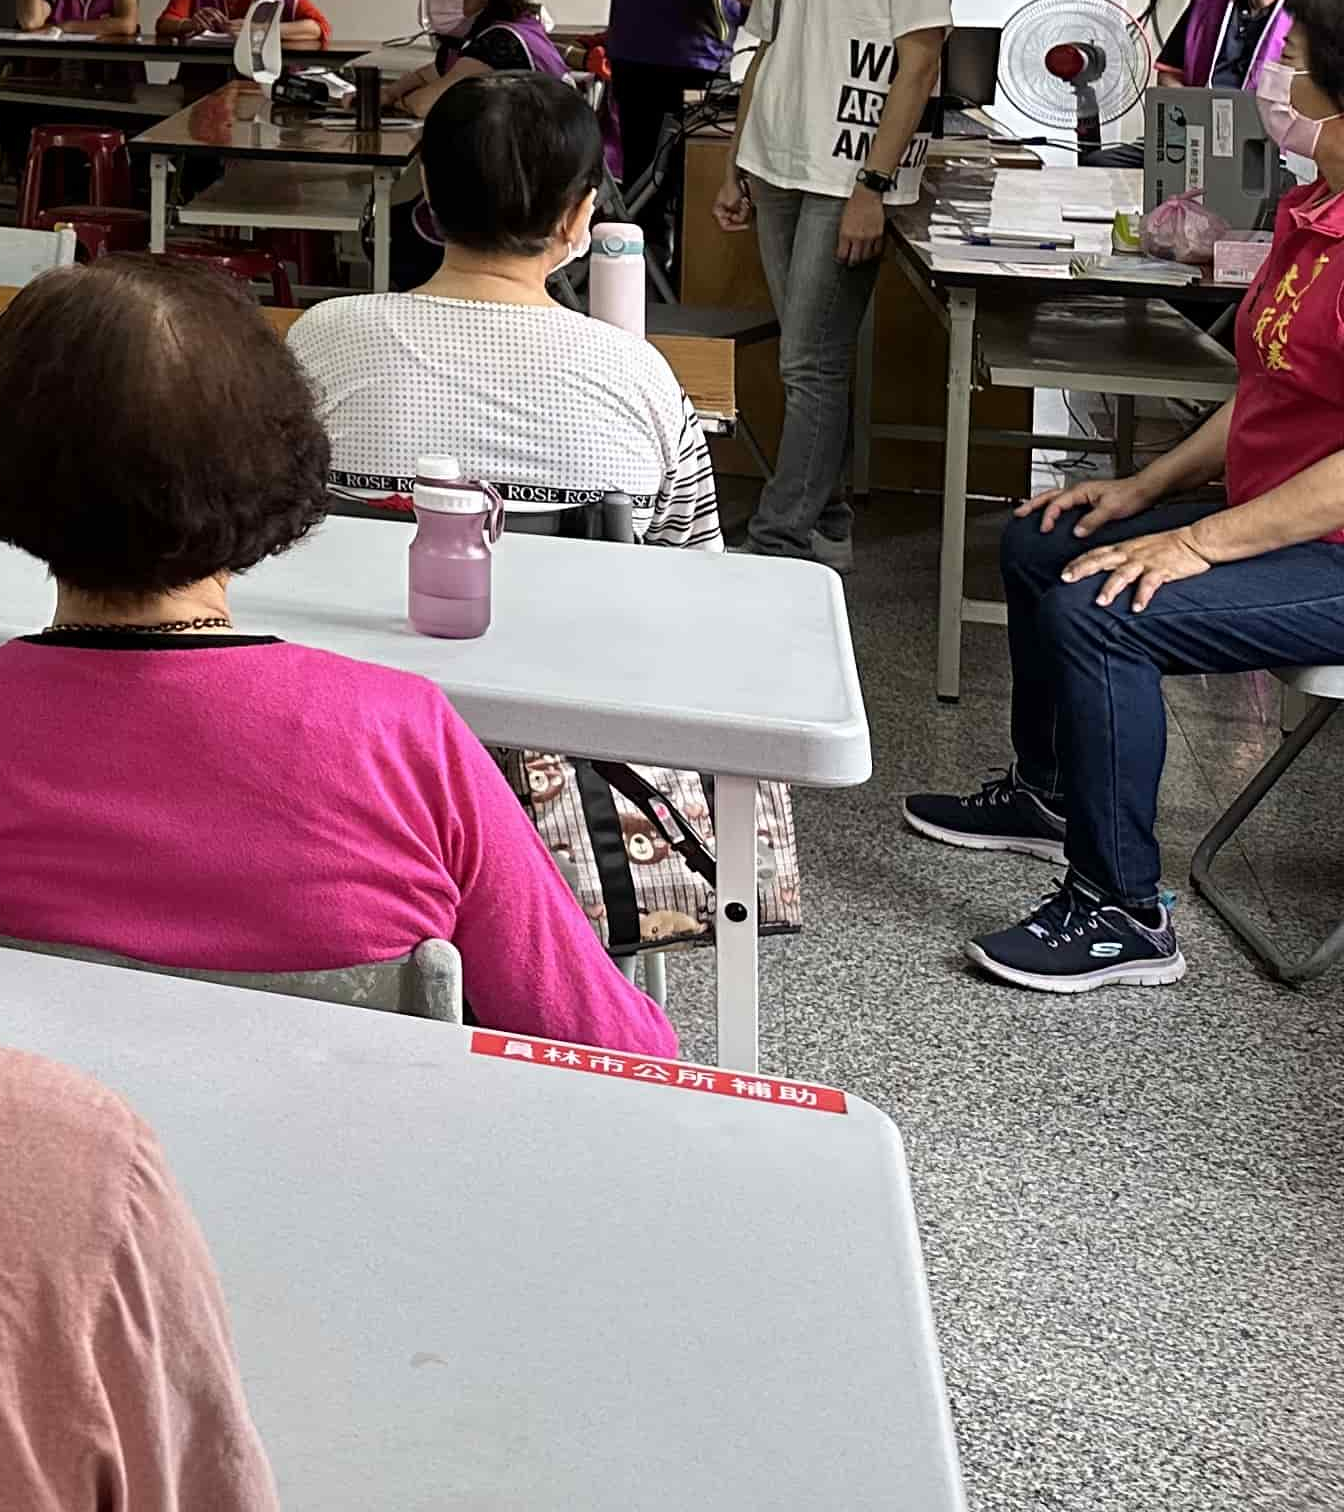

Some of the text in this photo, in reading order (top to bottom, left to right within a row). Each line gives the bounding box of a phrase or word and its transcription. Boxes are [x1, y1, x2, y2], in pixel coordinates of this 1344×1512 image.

[346, 473, 393, 490] ROSE
[507, 484, 560, 503] ROSE
[564, 490, 605, 504] ROS
[503, 1040, 819, 1107] 員林市公所 補助
